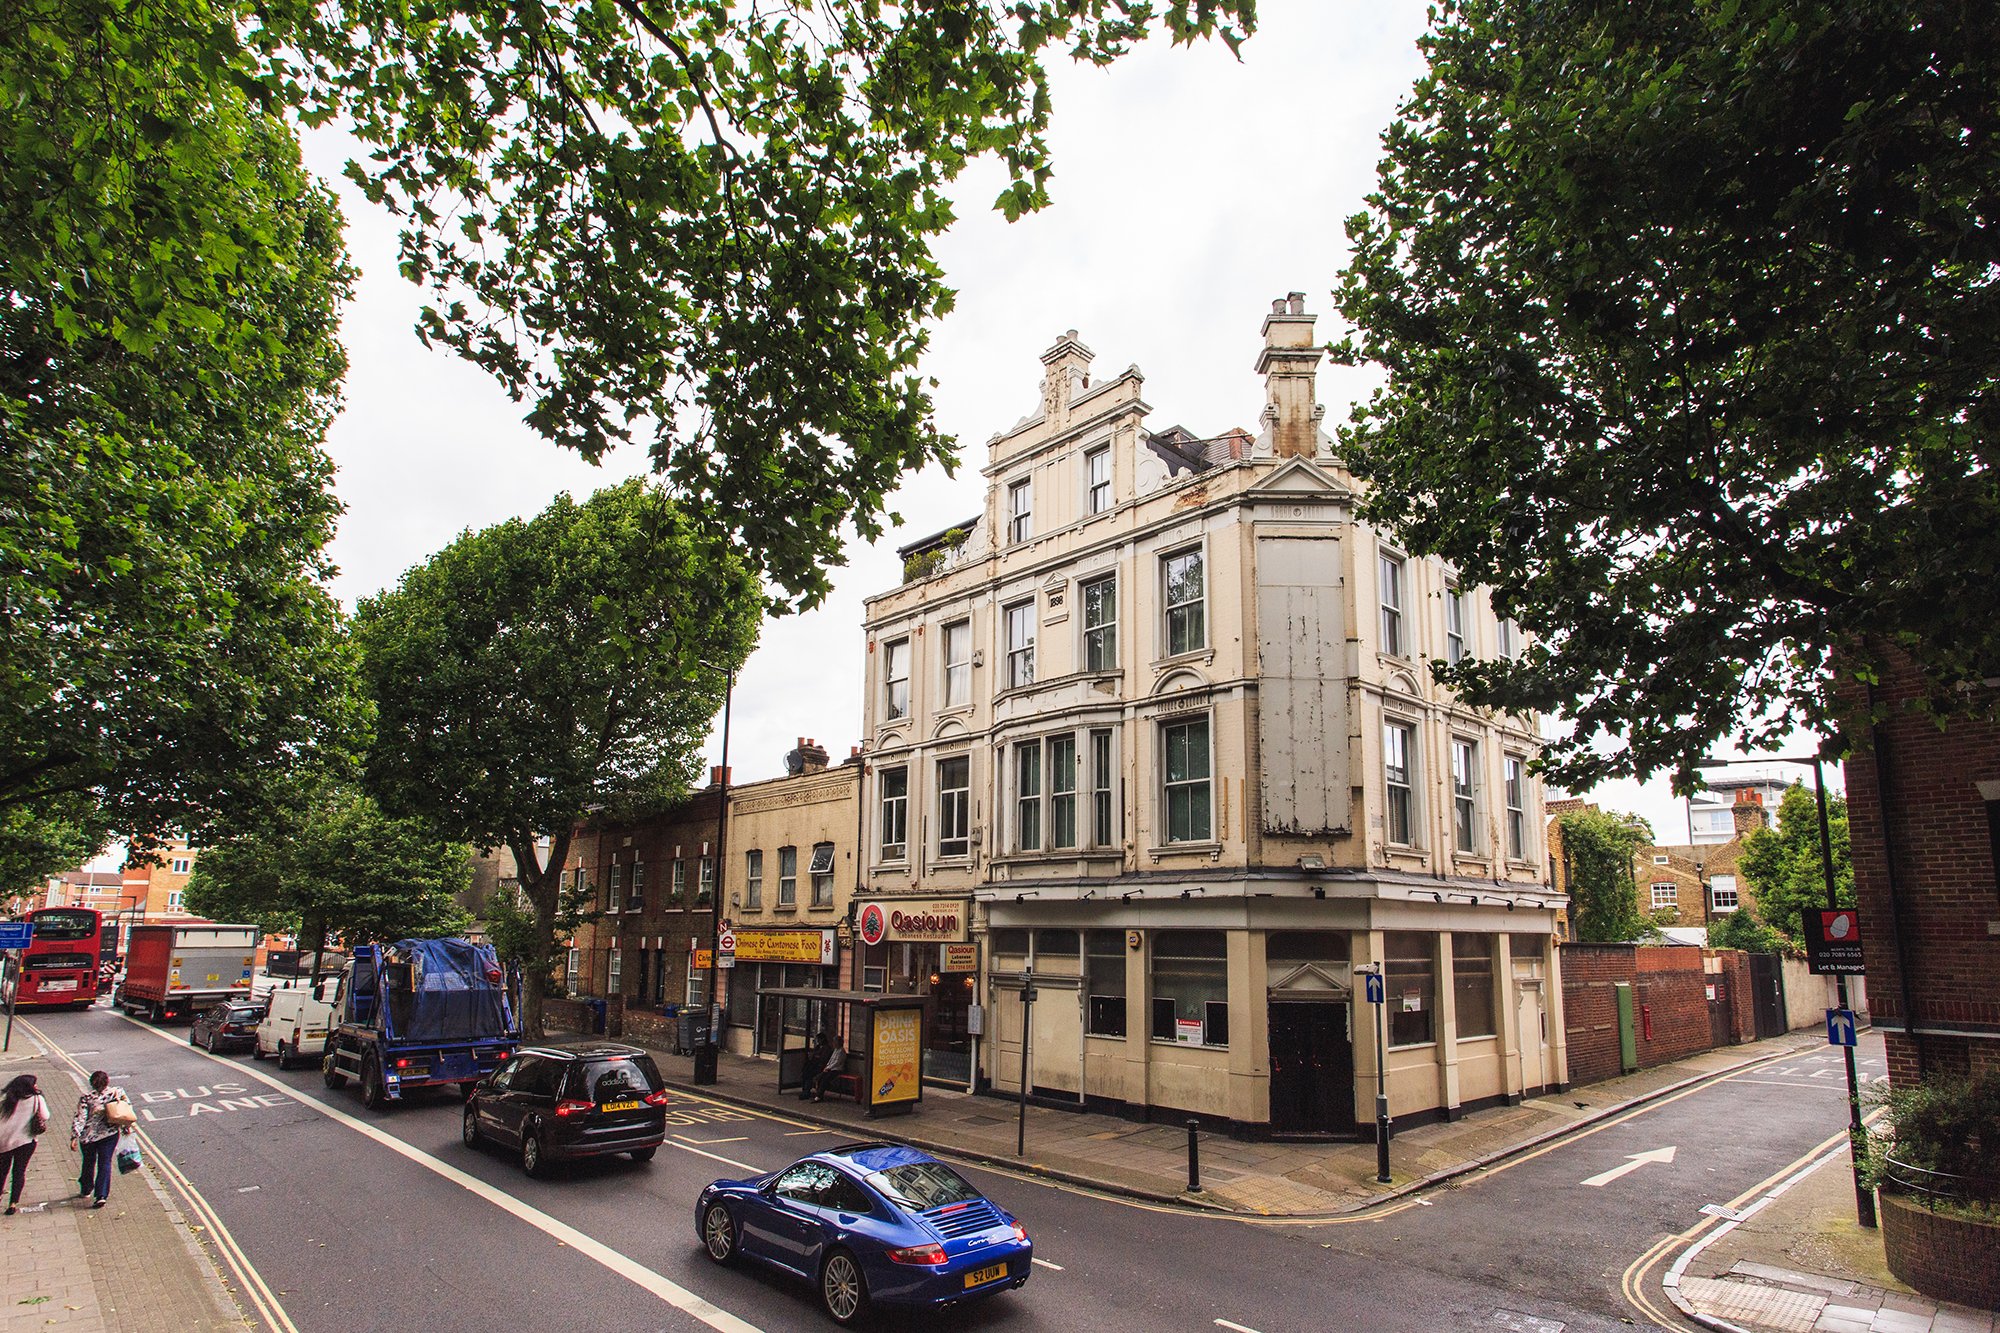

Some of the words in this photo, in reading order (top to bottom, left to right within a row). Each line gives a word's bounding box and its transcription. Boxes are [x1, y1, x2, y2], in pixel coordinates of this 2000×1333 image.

[891, 910, 958, 932] Qasioun
[759, 938, 765, 948] &
[767, 938, 799, 949] Cantonese
[801, 939, 817, 950] Food
[948, 945, 975, 954] Qasioun
[880, 1015, 915, 1029] DRINK
[880, 1029, 915, 1043] OASIS
[140, 1083, 247, 1103] BUS
[141, 1093, 296, 1121] LANE
